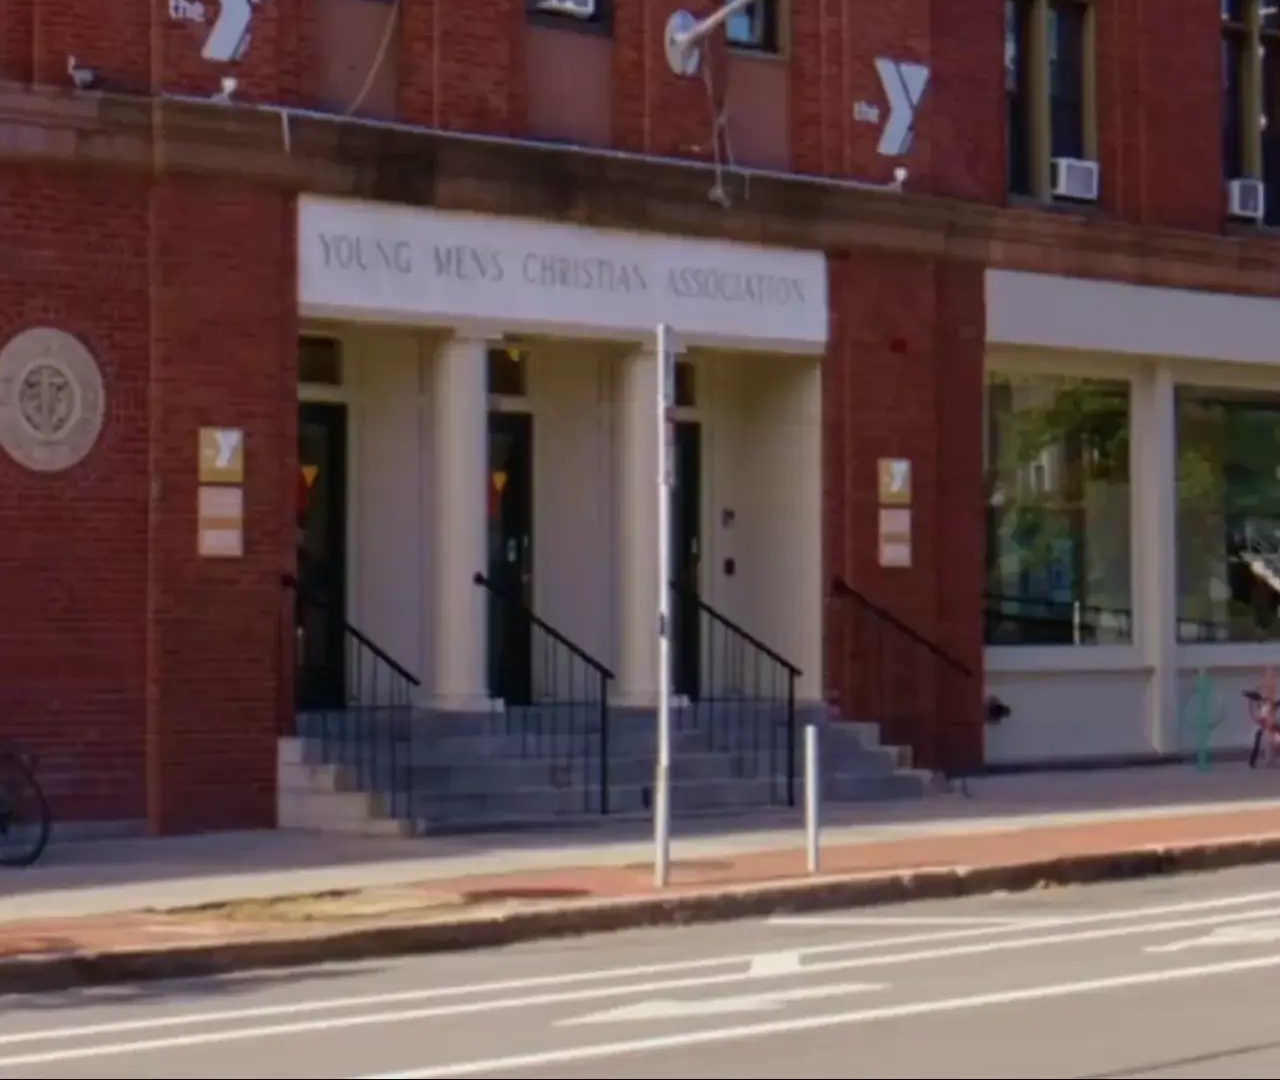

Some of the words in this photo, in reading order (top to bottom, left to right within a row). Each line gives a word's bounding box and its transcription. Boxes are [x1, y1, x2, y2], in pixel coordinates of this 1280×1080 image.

[317, 231, 412, 275] YOUNG
[522, 251, 647, 294] CHRISTIAN
[667, 266, 806, 306] ASSOCIATION
